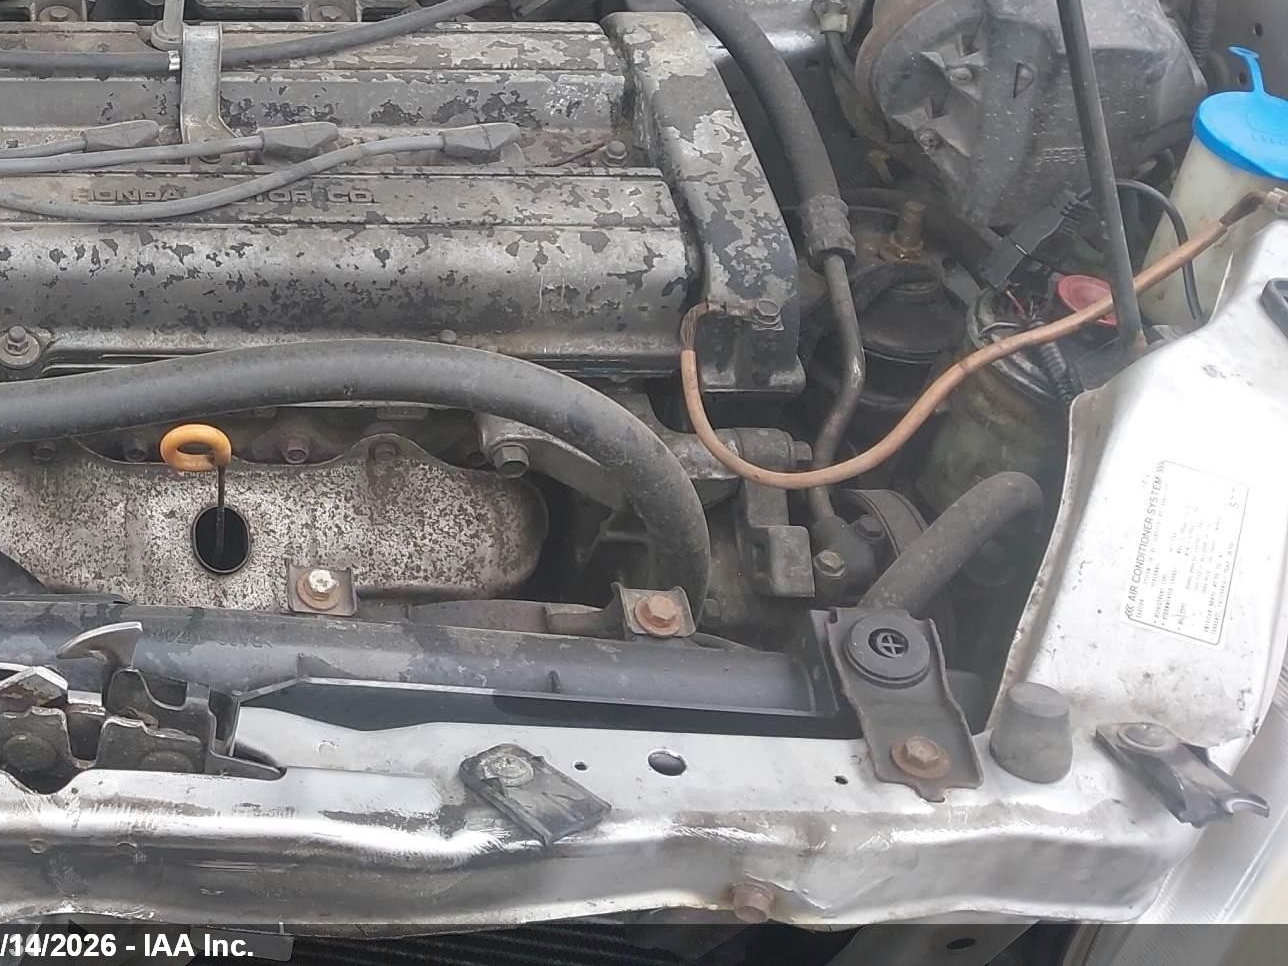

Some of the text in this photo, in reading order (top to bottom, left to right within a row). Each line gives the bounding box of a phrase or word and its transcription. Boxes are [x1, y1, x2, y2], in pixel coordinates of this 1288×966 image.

[72, 185, 182, 202] HONDA
[252, 188, 313, 203] TOR
[1127, 475, 1164, 603] AIR CONDITIONER SYSTEM
